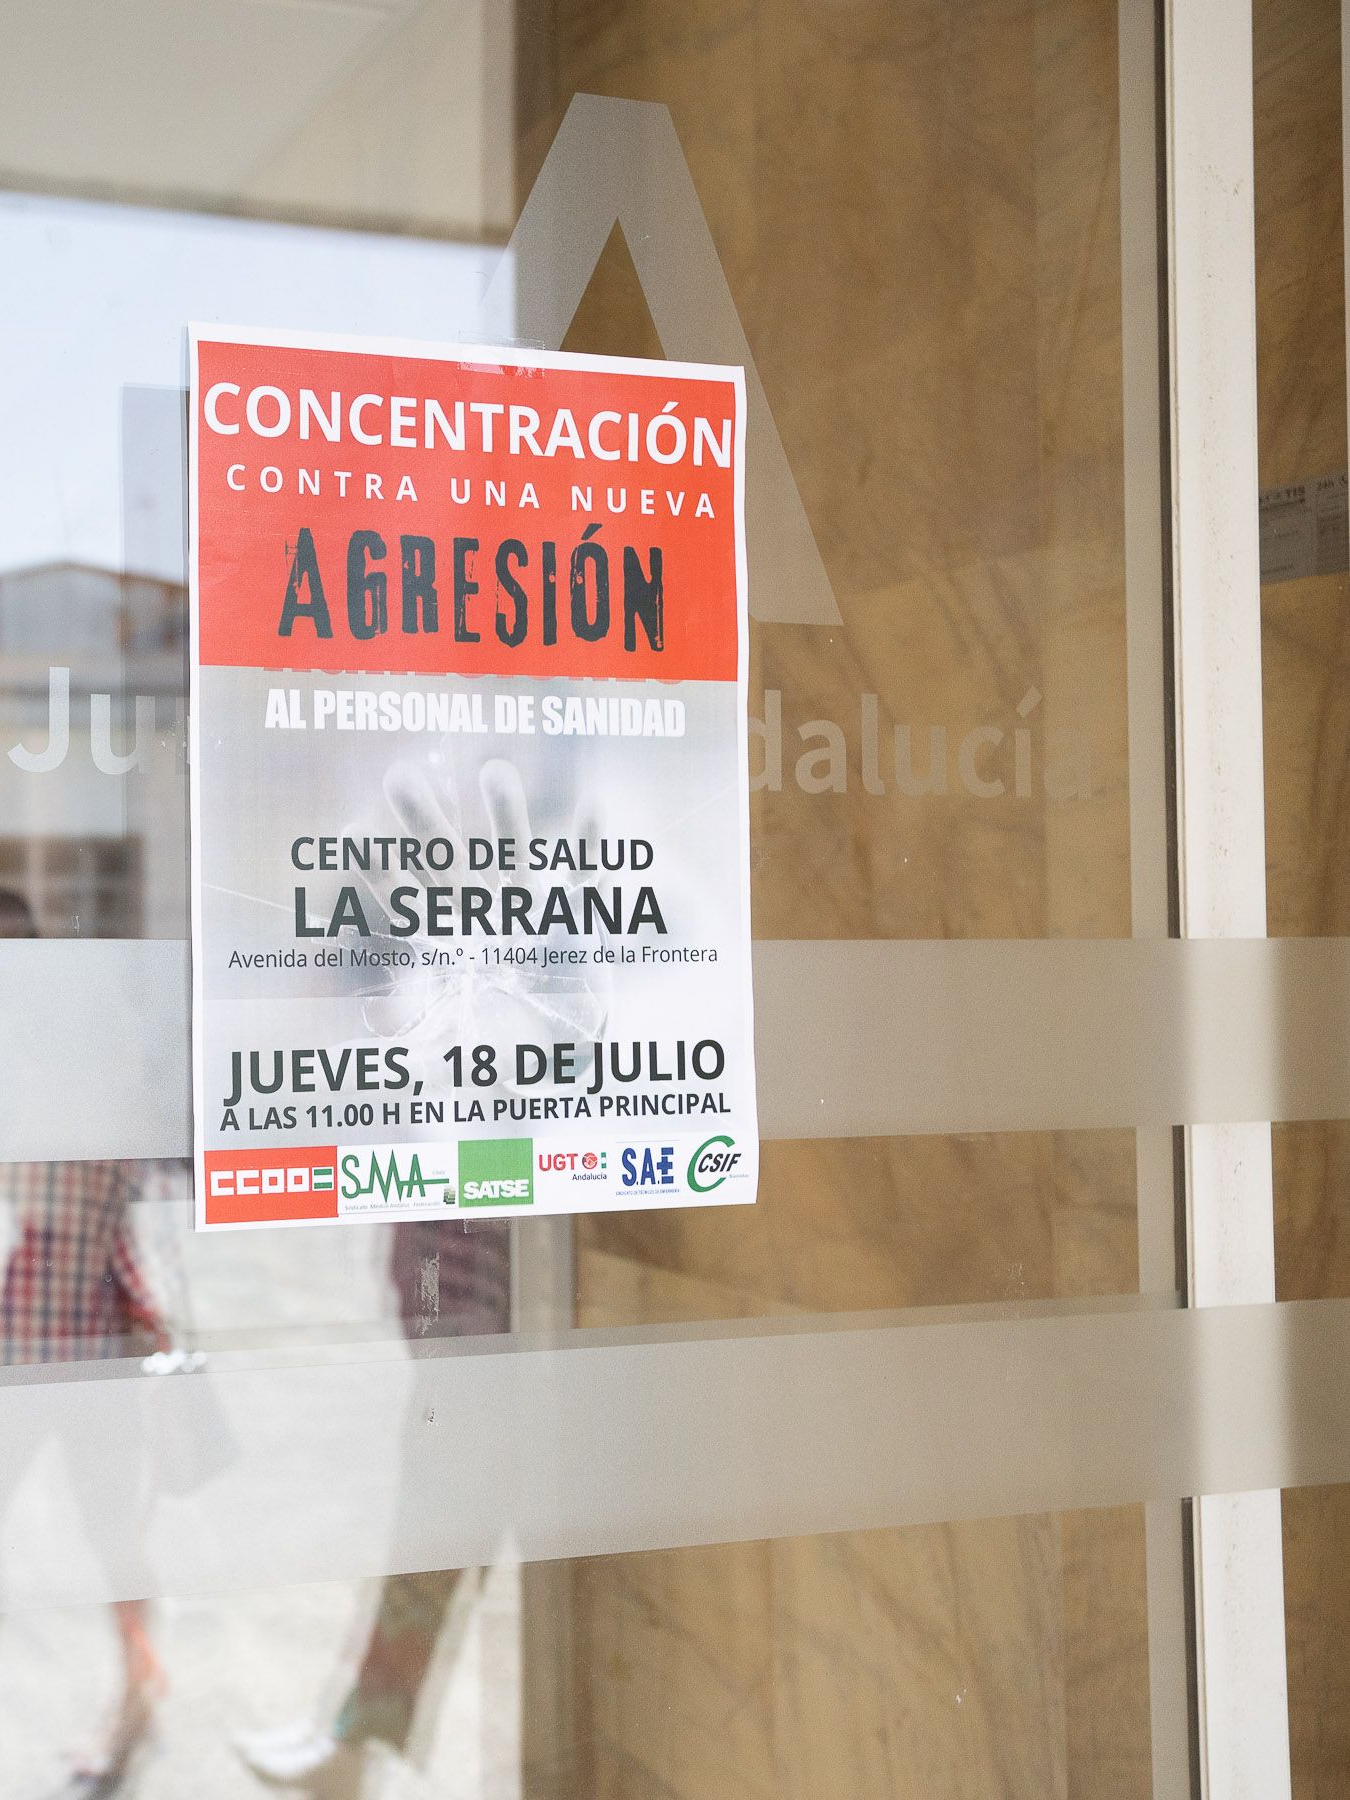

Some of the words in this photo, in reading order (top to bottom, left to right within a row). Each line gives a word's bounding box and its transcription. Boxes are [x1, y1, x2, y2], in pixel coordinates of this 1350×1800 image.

[203, 382, 732, 468] CONCENTRACIÓN
[226, 464, 419, 502] CONTRA
[451, 479, 540, 509] UNA
[571, 486, 715, 519] NUEVA
[277, 523, 664, 652] AGRESIÓN
[264, 688, 306, 729] AL
[314, 689, 487, 733] PERSONAL
[495, 695, 535, 735] DE
[541, 695, 685, 737] SANIDAD
[291, 837, 454, 871] CENTRO
[469, 838, 516, 871] DE
[528, 838, 653, 871] SALUD
[294, 886, 371, 938] LA
[390, 886, 667, 937] SERRANA
[228, 950, 307, 968] Avenida
[313, 949, 344, 968] del
[350, 948, 416, 970] Mosto,
[482, 946, 538, 965] 11404
[541, 947, 588, 968] Jerez
[593, 946, 615, 964] de
[620, 945, 636, 963] la
[642, 945, 718, 963] Frontera
[223, 1046, 425, 1107] JUEVES,
[442, 1044, 496, 1088] 18
[517, 1042, 576, 1086] DE
[588, 1039, 725, 1094] JULIO
[220, 1110, 240, 1131] A
[250, 1106, 298, 1130] LAS
[305, 1103, 374, 1128] 11.00
[383, 1102, 400, 1125] H
[411, 1101, 445, 1124] EN
[454, 1099, 486, 1123] LA
[493, 1096, 591, 1121] PUERTA
[600, 1092, 731, 1118] PRINCIPAL
[538, 1152, 578, 1172] UGT
[572, 1173, 607, 1181] Andalucía
[698, 1153, 741, 1173] CSIF
[210, 1168, 309, 1196] CCOO
[464, 1179, 529, 1200] SATSE
